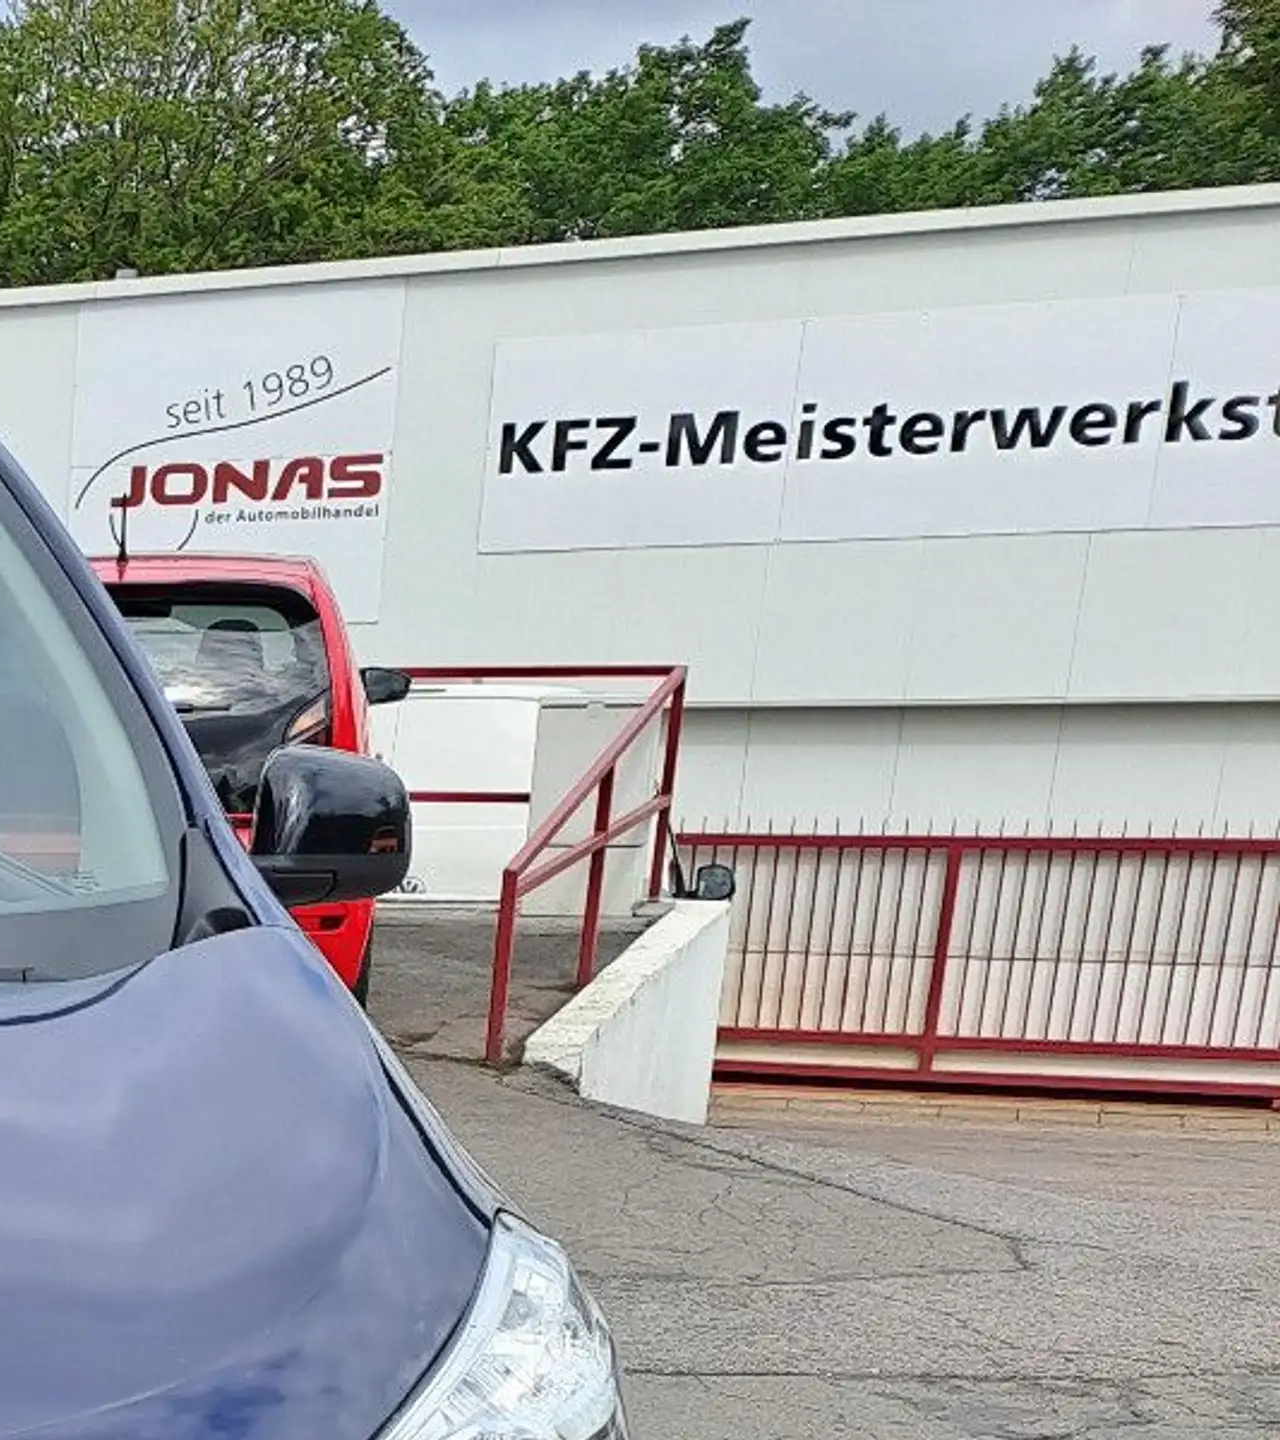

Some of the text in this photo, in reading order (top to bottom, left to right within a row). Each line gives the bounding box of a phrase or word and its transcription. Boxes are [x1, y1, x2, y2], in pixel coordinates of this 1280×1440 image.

[166, 355, 335, 429] seit 1989
[111, 453, 385, 508] JONAS
[204, 503, 380, 526] der Automobilhandel
